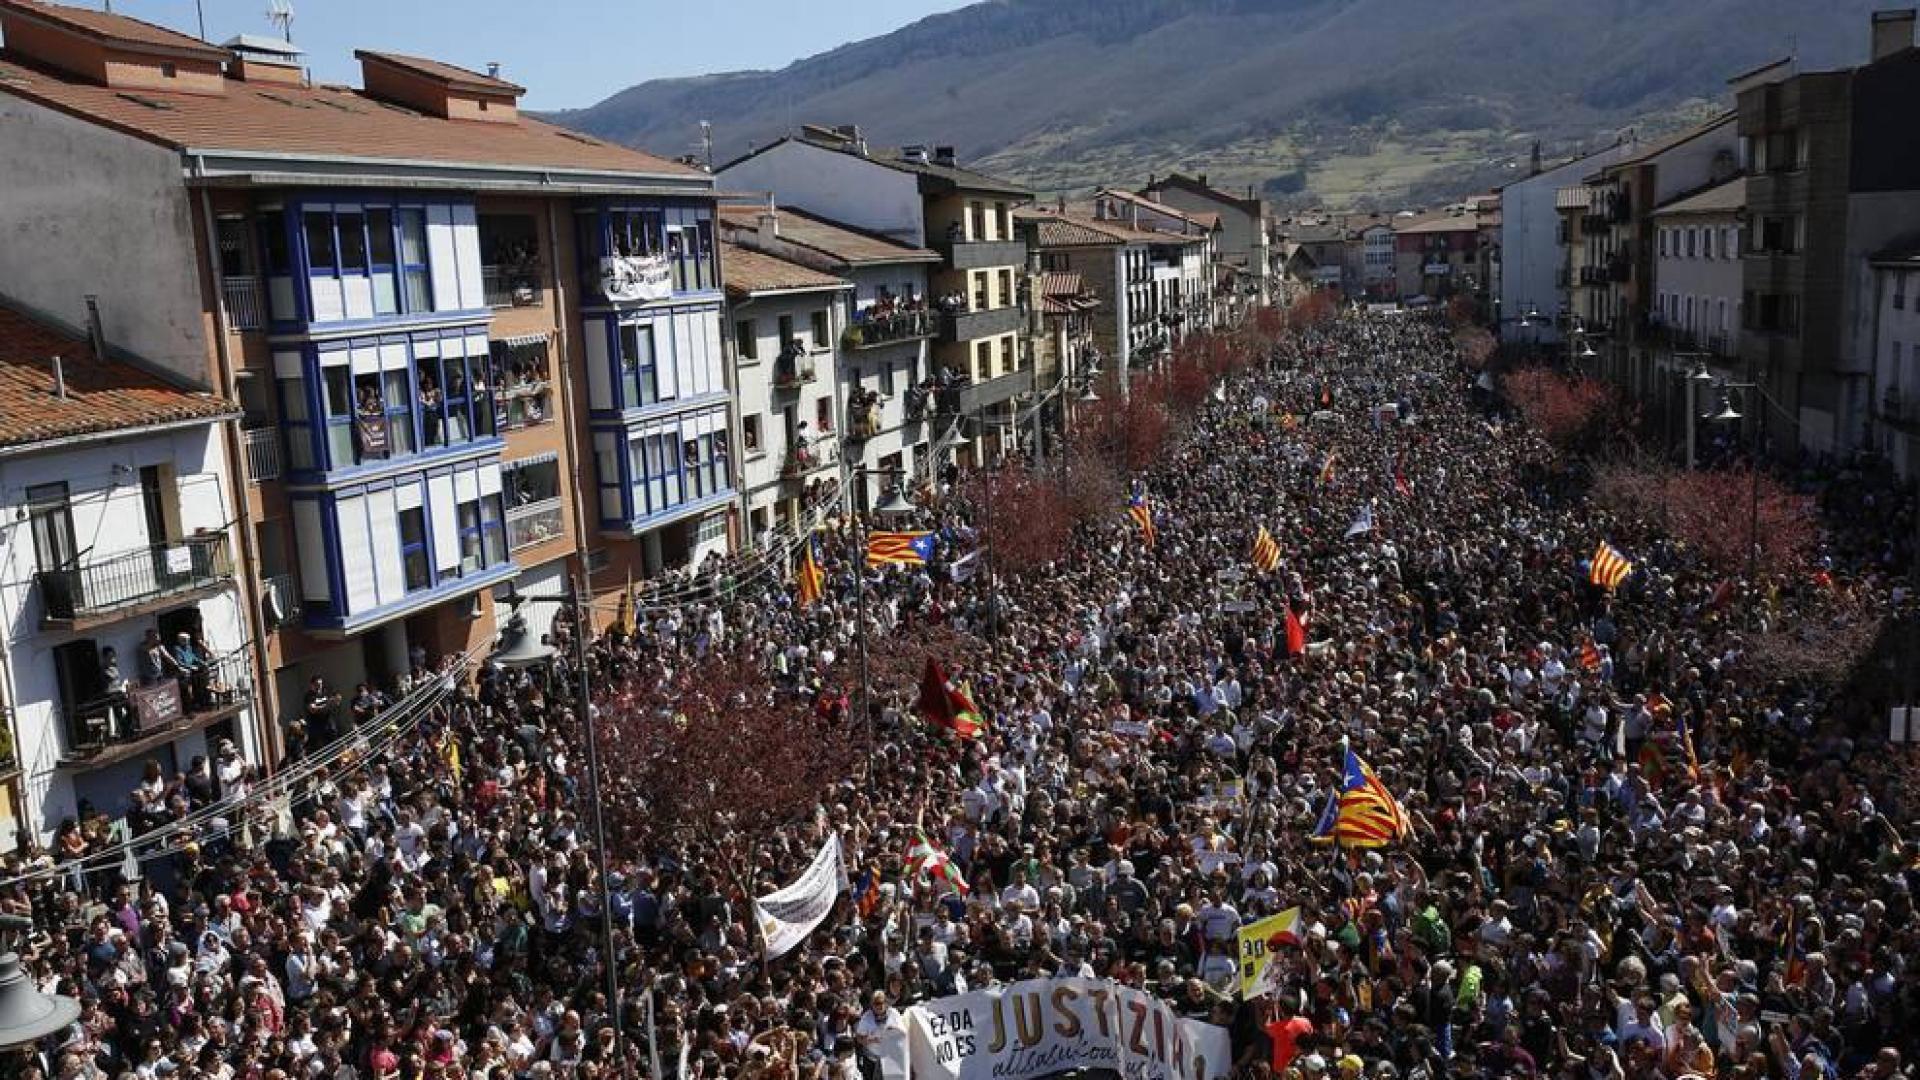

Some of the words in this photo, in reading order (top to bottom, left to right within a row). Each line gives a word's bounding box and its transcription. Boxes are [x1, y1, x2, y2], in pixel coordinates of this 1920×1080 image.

[930, 1013, 947, 1037] EZ
[950, 1008, 974, 1032] DA
[936, 1040, 953, 1064] NO
[955, 1035, 976, 1057] ES
